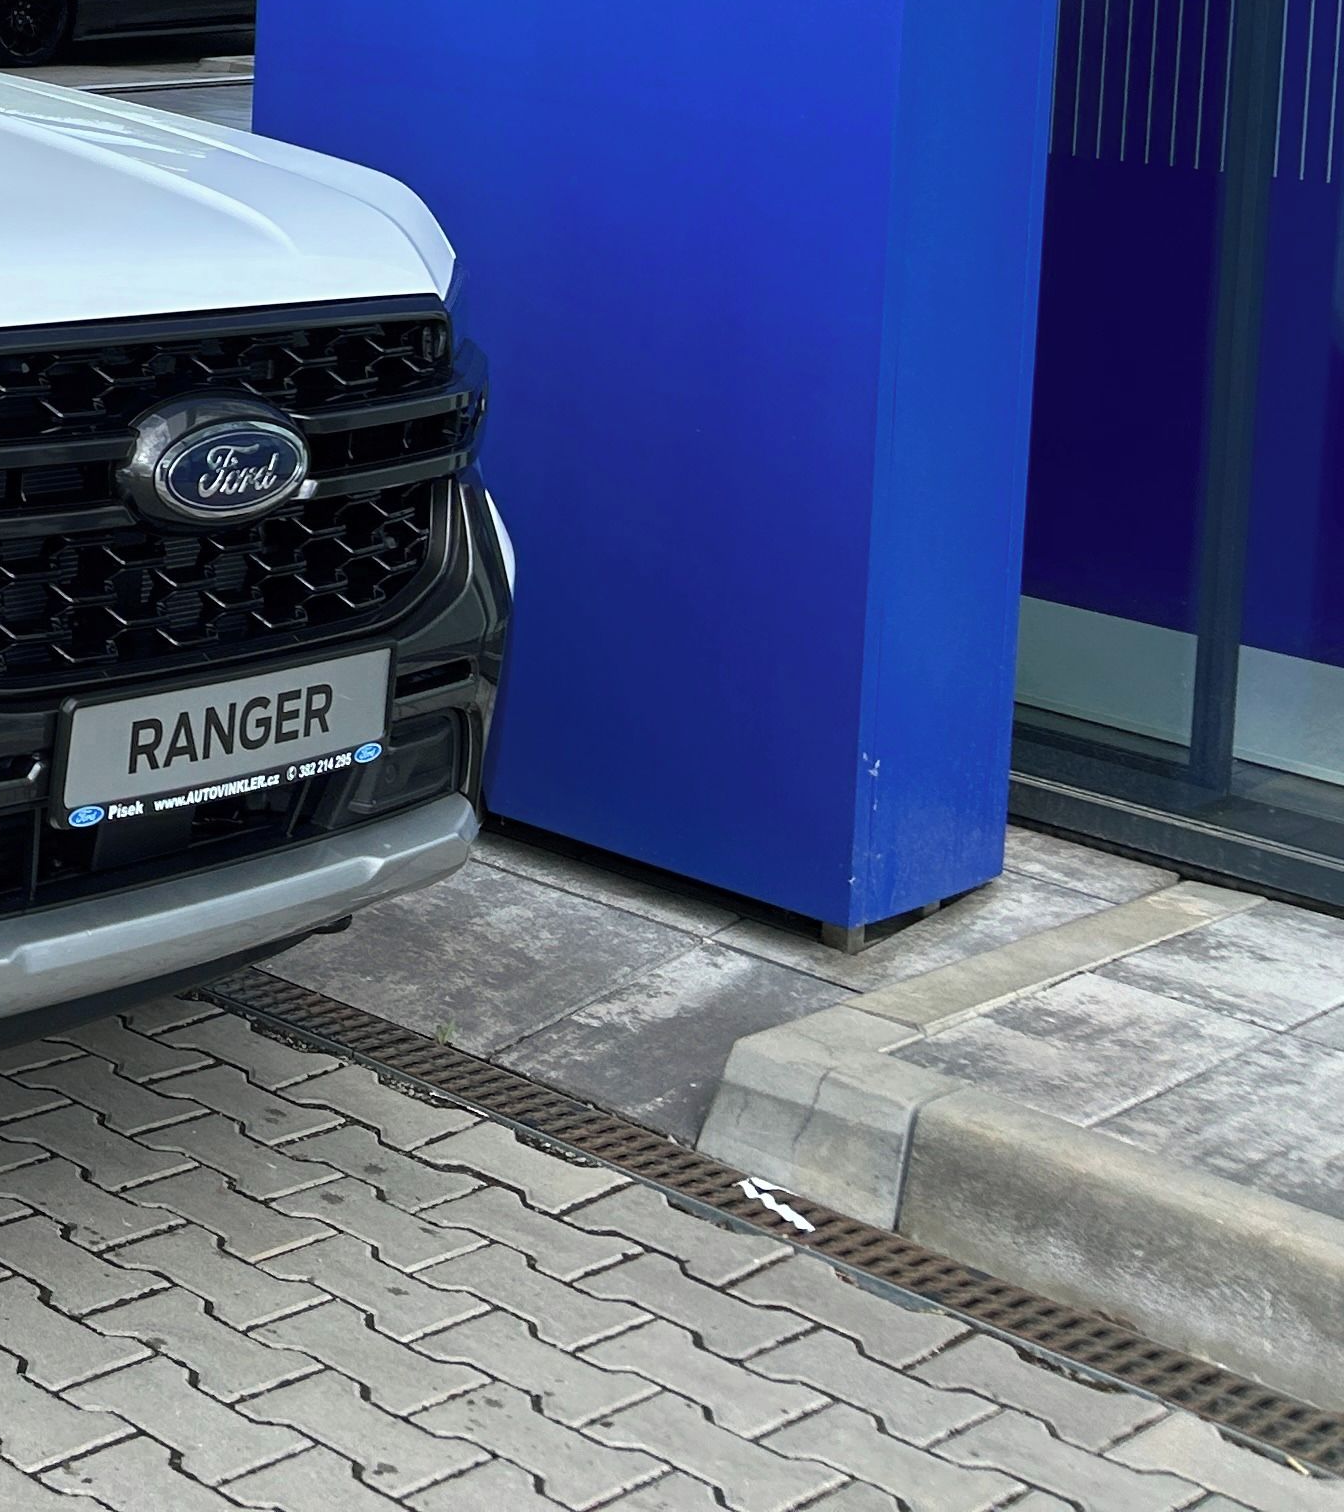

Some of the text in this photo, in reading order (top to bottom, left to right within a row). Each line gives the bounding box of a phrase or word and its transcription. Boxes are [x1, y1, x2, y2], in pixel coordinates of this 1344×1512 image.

[198, 443, 280, 498] Ford
[128, 683, 333, 774] RANGER
[154, 774, 280, 811] www.AUTOVINKLER.cz
[317, 757, 334, 773] 214
